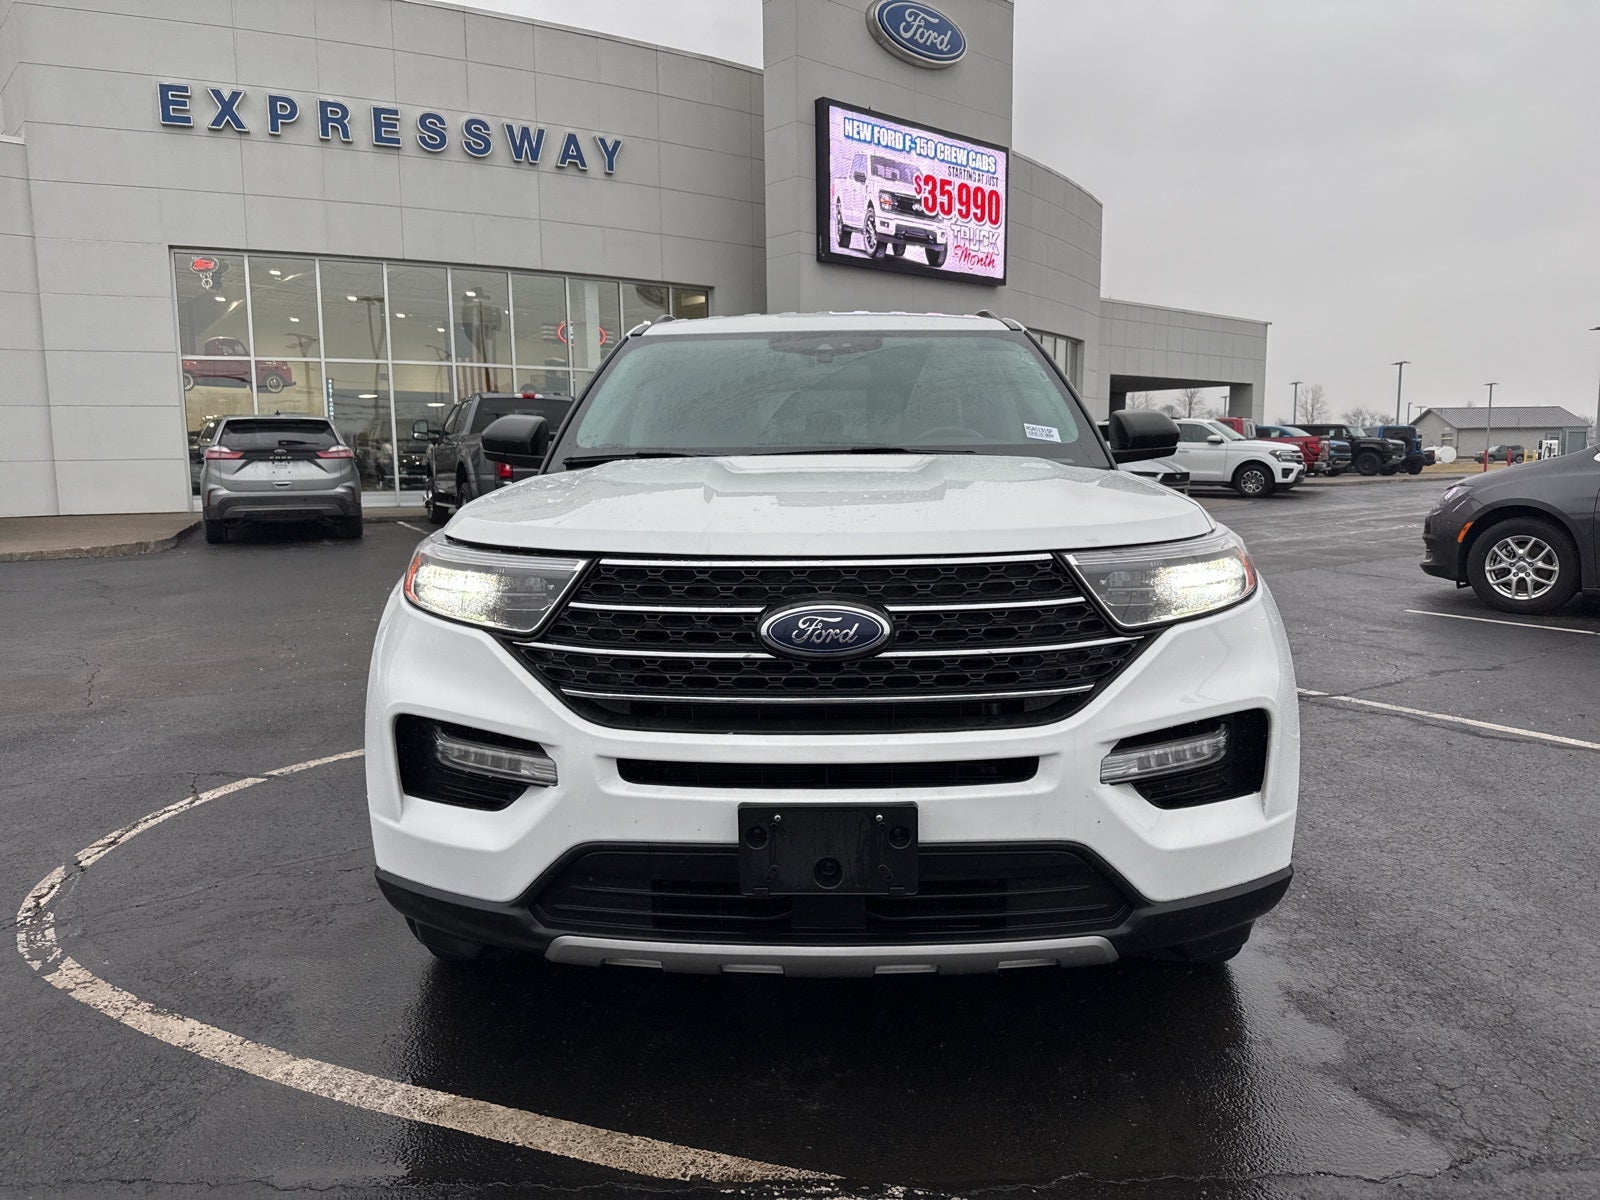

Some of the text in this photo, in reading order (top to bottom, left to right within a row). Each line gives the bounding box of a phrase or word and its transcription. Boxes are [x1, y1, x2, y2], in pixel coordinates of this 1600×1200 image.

[900, 8, 952, 52] Ford
[157, 82, 624, 174] EXPRESSWAY
[844, 117, 997, 174] NEW FORD F-150 CREW CABS
[947, 165, 999, 188] STARTING AT JUST
[950, 223, 1000, 256] TRUCK
[953, 245, 996, 270] Month
[791, 615, 860, 644] Ford
